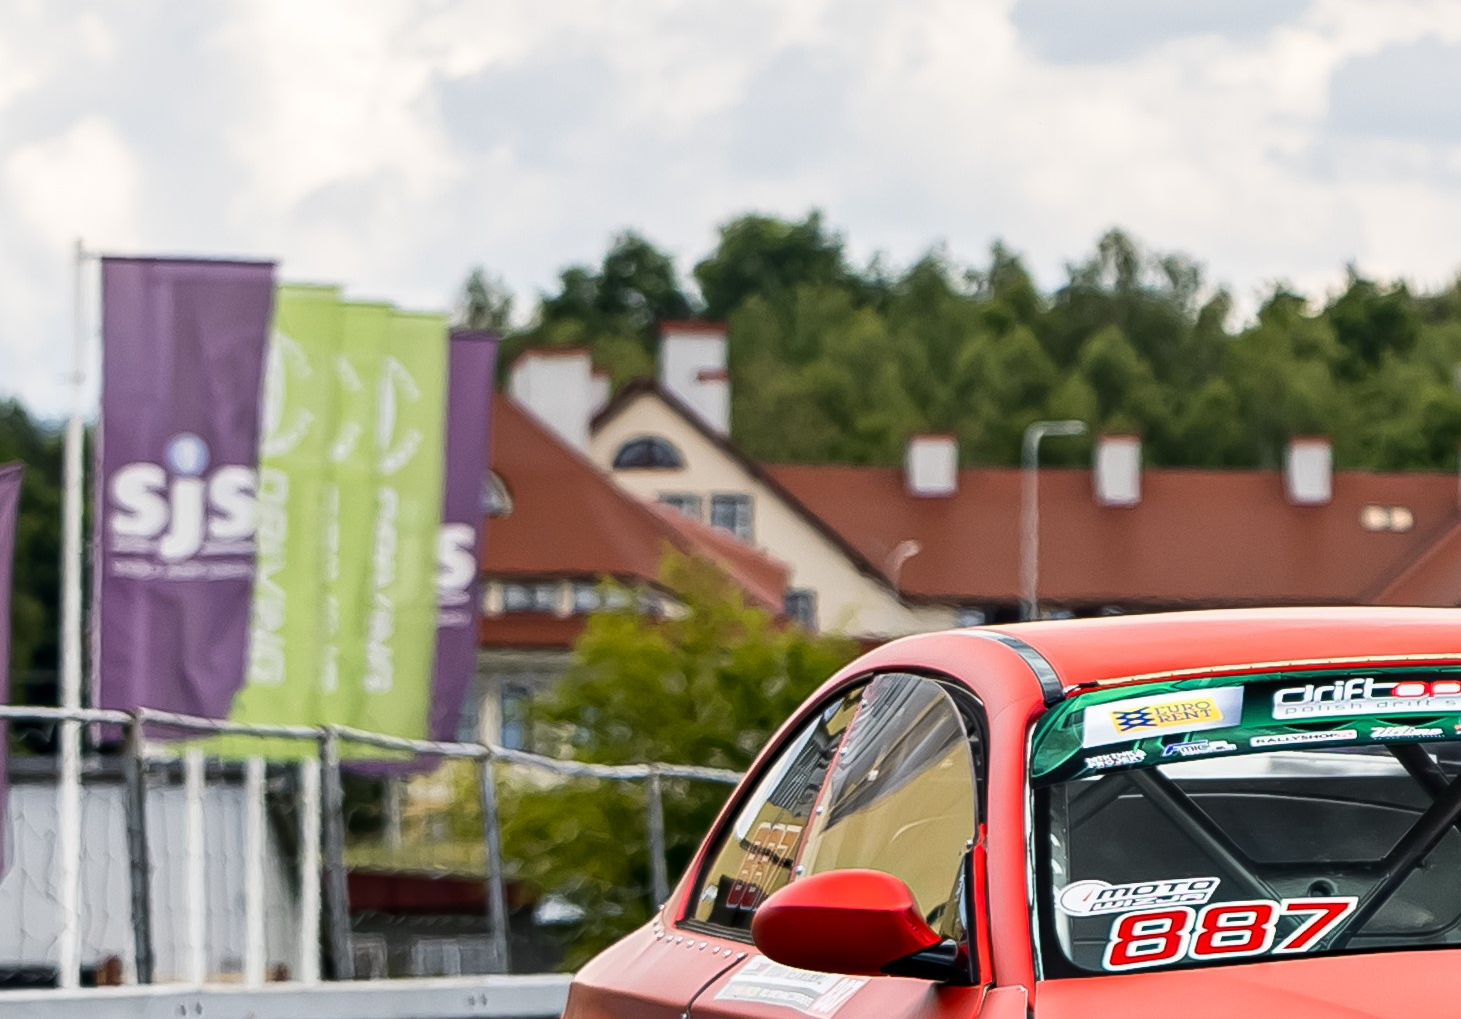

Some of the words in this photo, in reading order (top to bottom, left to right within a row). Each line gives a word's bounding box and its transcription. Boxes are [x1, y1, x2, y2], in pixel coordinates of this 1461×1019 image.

[1154, 701, 1210, 715] EURO
[1158, 708, 1212, 723] RENT
[1096, 880, 1215, 900] MOTO
[1104, 897, 1357, 970] 887
